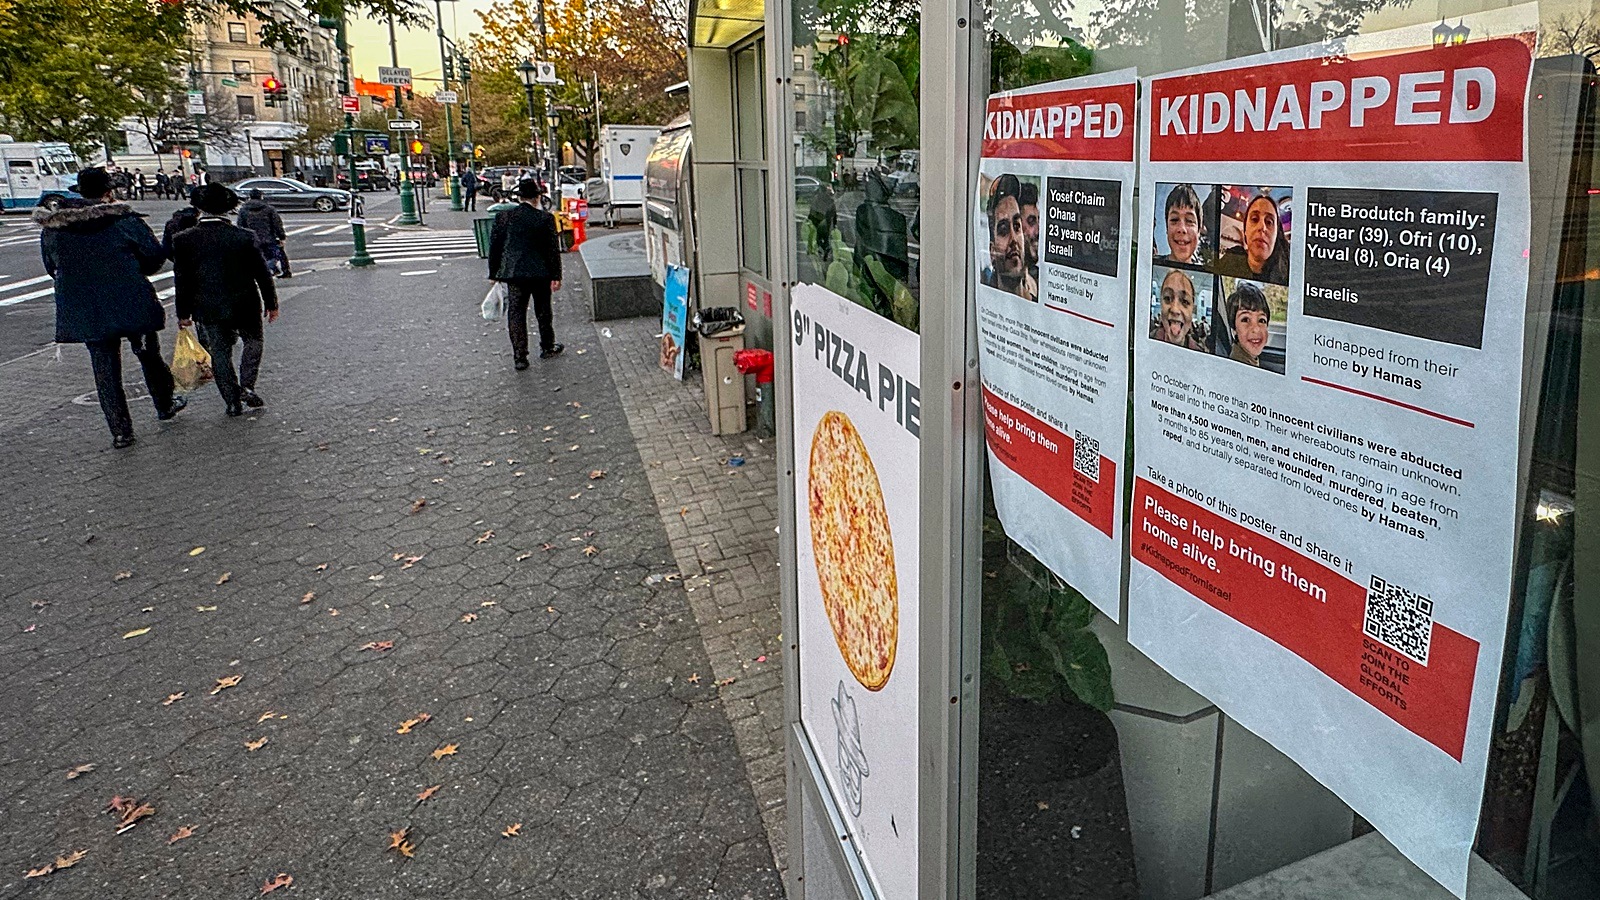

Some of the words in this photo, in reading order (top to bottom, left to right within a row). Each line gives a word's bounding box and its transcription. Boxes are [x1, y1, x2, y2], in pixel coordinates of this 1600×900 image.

[382, 77, 410, 85] GREEN
[1159, 66, 1496, 136] KIDNAPPED
[983, 102, 1124, 140] KIDNAPPED
[1049, 207, 1076, 222] Ohana
[1050, 189, 1074, 203] Yosef
[1075, 191, 1105, 207] Chaim
[1308, 202, 1336, 218] The
[1341, 204, 1415, 223] Brodutch
[1420, 208, 1486, 231] family:
[1048, 241, 1073, 257] Israeli
[1049, 224, 1059, 236] 23
[1061, 228, 1083, 242] years
[1085, 231, 1101, 245] old
[1307, 223, 1355, 243] Hagar
[1359, 226, 1394, 247] (39),
[1399, 230, 1433, 248] Ofri
[1439, 233, 1483, 256] (10),
[1048, 267, 1079, 282] Kidnapped
[1080, 274, 1093, 286] from
[1307, 243, 1349, 262] Yuval
[1354, 248, 1379, 268] (8),
[1384, 251, 1420, 270] Oria
[1425, 255, 1450, 278] (4)
[1047, 292, 1068, 305] Hamas
[1048, 281, 1065, 291] music
[1085, 290, 1094, 301] by
[1305, 283, 1359, 304] Israelis
[1083, 347, 1109, 362] abducted
[1313, 352, 1348, 370] home
[1352, 362, 1369, 378] by
[1373, 366, 1422, 390] Hamas
[1314, 333, 1385, 360] Kidnapped
[1388, 350, 1419, 369] from
[1424, 359, 1459, 378] their
[794, 309, 810, 346] 9"
[814, 321, 872, 402] PIZZA
[879, 362, 920, 440] PIE
[996, 425, 1012, 445] alive.
[999, 409, 1014, 429] help
[1015, 419, 1036, 443] bring
[1037, 432, 1058, 454] them
[1151, 371, 1162, 381] On
[1164, 375, 1190, 391] October
[1192, 384, 1206, 397] 7th,
[1209, 391, 1229, 403] more
[1231, 397, 1248, 410] than
[1251, 403, 1267, 416] 200
[1269, 408, 1314, 431] innocent
[1317, 425, 1364, 446] civilians
[1367, 440, 1397, 457] were
[1400, 451, 1463, 480] abducted
[1151, 383, 1166, 394] from
[1168, 388, 1185, 402] Israel
[1187, 395, 1200, 407] into
[1202, 401, 1215, 411] the
[1217, 405, 1239, 419] Gaza
[1241, 412, 1262, 428] Strip.
[1265, 420, 1287, 435] Their
[1290, 431, 1356, 459] whereabouts
[1359, 453, 1398, 474] remain
[1402, 468, 1461, 497] unknown.
[1151, 399, 1169, 413] More
[1170, 406, 1186, 419] than
[1187, 413, 1209, 428] 4,500
[1210, 422, 1244, 441] women,
[1247, 435, 1269, 451] men,
[1271, 444, 1290, 457] and
[1293, 451, 1338, 476] children,
[1341, 469, 1383, 494] ranging
[1387, 484, 1397, 497] in
[1401, 491, 1426, 506] age
[1430, 498, 1459, 520] from
[1158, 414, 1163, 423] 3
[1164, 417, 1188, 433] months
[1189, 427, 1197, 436] to
[1199, 430, 1209, 440] 85
[1211, 435, 1234, 450] years
[1235, 444, 1251, 457] old,
[1254, 451, 1275, 464] were
[1277, 460, 1325, 486] wounded,
[1329, 480, 1387, 511] murdered,
[1391, 502, 1441, 531] beaten,
[1162, 429, 1184, 445] raped,
[1186, 439, 1200, 450] and
[1202, 444, 1233, 463] brutally
[1234, 457, 1278, 480] separated
[1280, 473, 1301, 489] from
[1303, 482, 1330, 501] loved
[1333, 496, 1358, 513] ones
[1361, 506, 1375, 522] by
[1379, 513, 1428, 541] Hamas.
[1147, 465, 1166, 485] Take
[1168, 479, 1174, 489] a
[1176, 482, 1204, 502] photo
[1206, 492, 1216, 507] of
[1218, 500, 1237, 518] this
[1240, 510, 1277, 535] poster
[1280, 528, 1303, 548] and
[1305, 541, 1341, 568] share
[1344, 558, 1354, 575] it
[1143, 517, 1178, 549] home
[1182, 542, 1221, 574] alive.
[1144, 495, 1188, 531] Please
[1192, 519, 1225, 551] help
[1229, 538, 1276, 578] bring
[1281, 564, 1327, 604] them
[1141, 542, 1231, 602] #KidnappedFromIsrael
[1361, 652, 1385, 671] JOIN
[1388, 665, 1410, 685] THE
[1362, 639, 1392, 661] SCAN
[1395, 655, 1409, 671] TO
[1360, 674, 1407, 710] EFFORTS
[1361, 663, 1403, 695] GLOBAL
